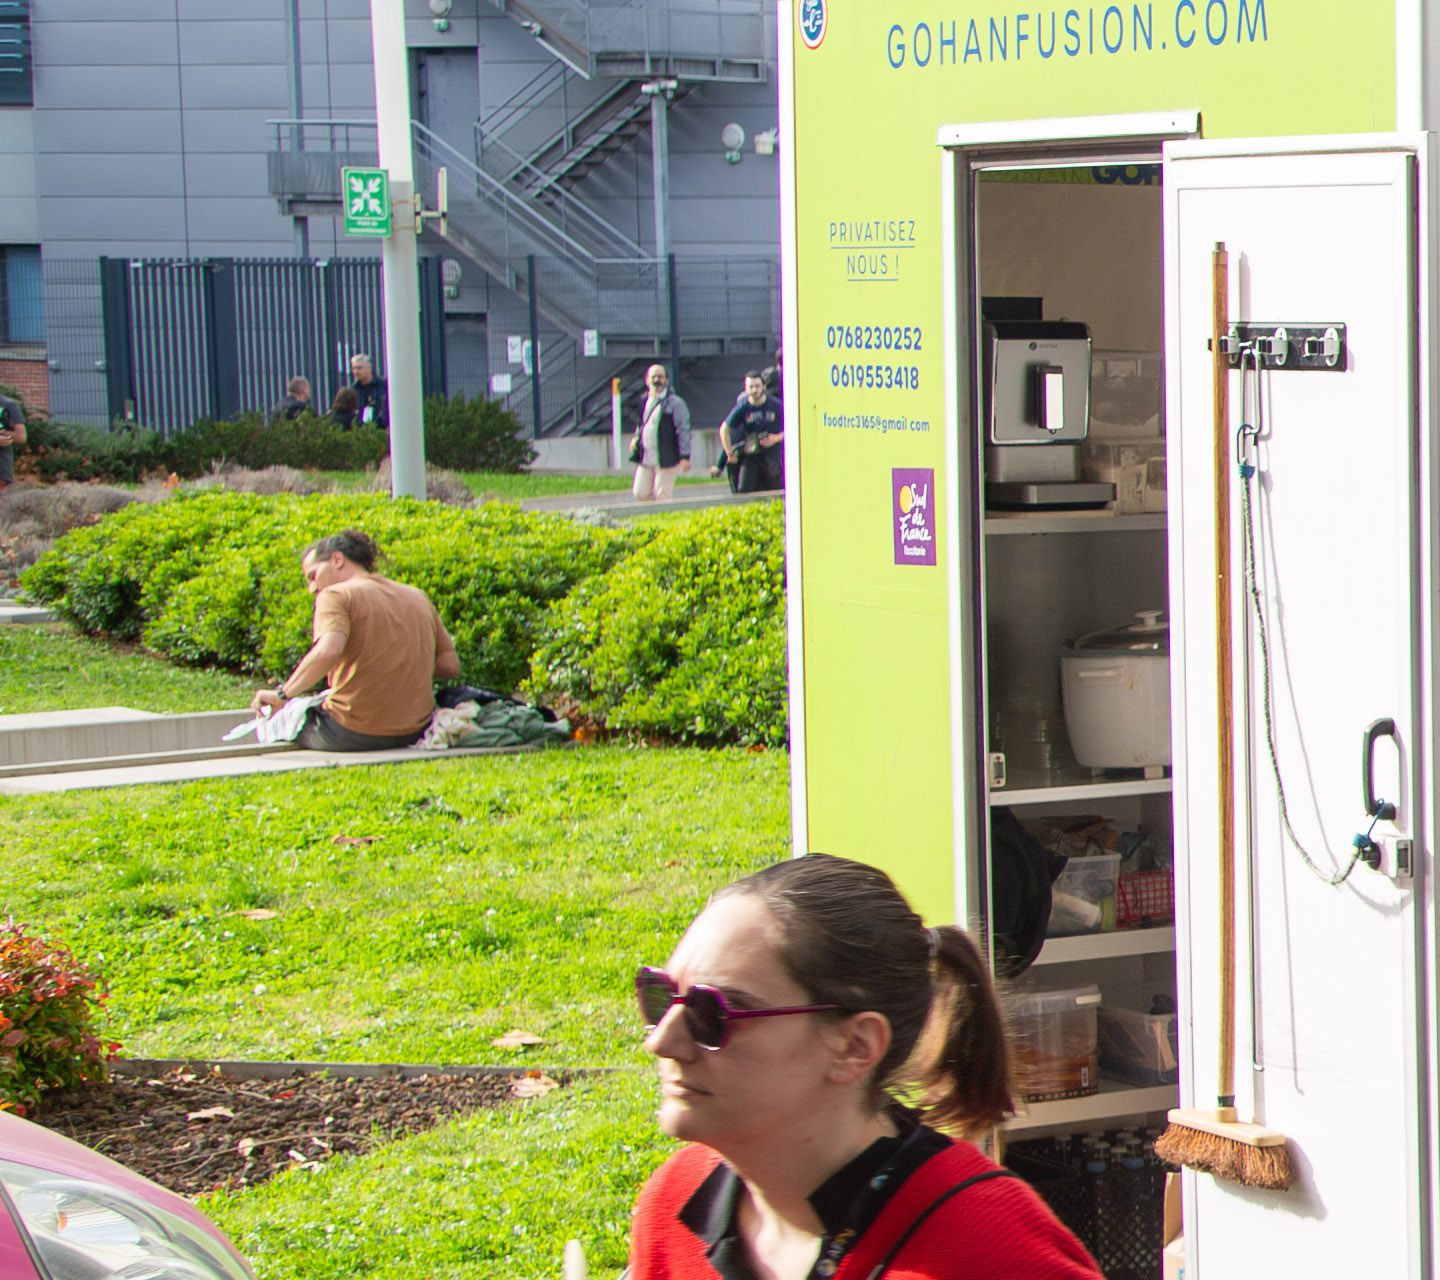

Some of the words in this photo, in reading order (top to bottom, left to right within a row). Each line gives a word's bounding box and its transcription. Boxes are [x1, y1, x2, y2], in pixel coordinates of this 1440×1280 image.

[829, 220, 916, 242] PRIVATISEZ
[847, 255, 888, 274] NOUS
[827, 326, 922, 350] 0768230252
[831, 365, 919, 390] 0619553418
[908, 483, 927, 509] Sud
[899, 513, 932, 544] France
[912, 508, 925, 526] de
